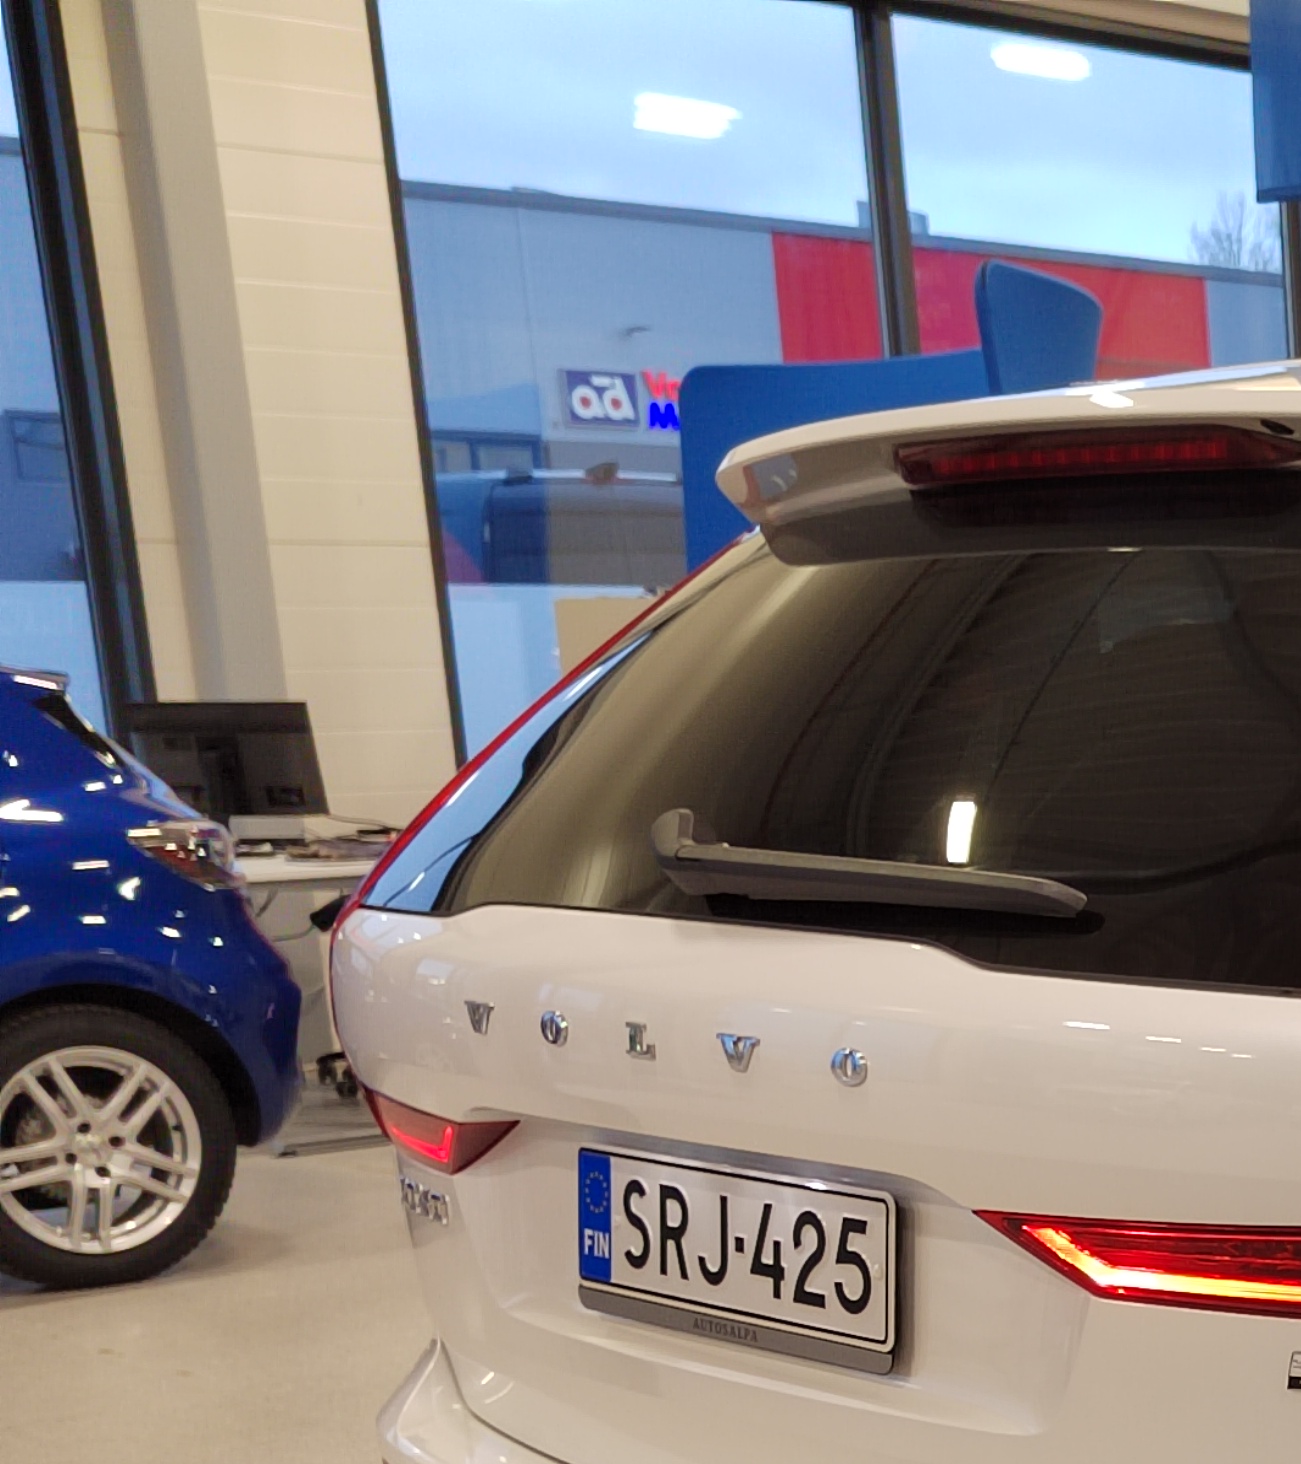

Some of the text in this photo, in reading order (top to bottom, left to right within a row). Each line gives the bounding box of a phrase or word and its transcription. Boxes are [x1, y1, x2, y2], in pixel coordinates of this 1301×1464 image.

[464, 999, 870, 1088] VOLVO
[583, 1228, 611, 1260] FIN
[622, 1178, 873, 1315] SRJ-425
[692, 1316, 760, 1344] AUTOSALPA
